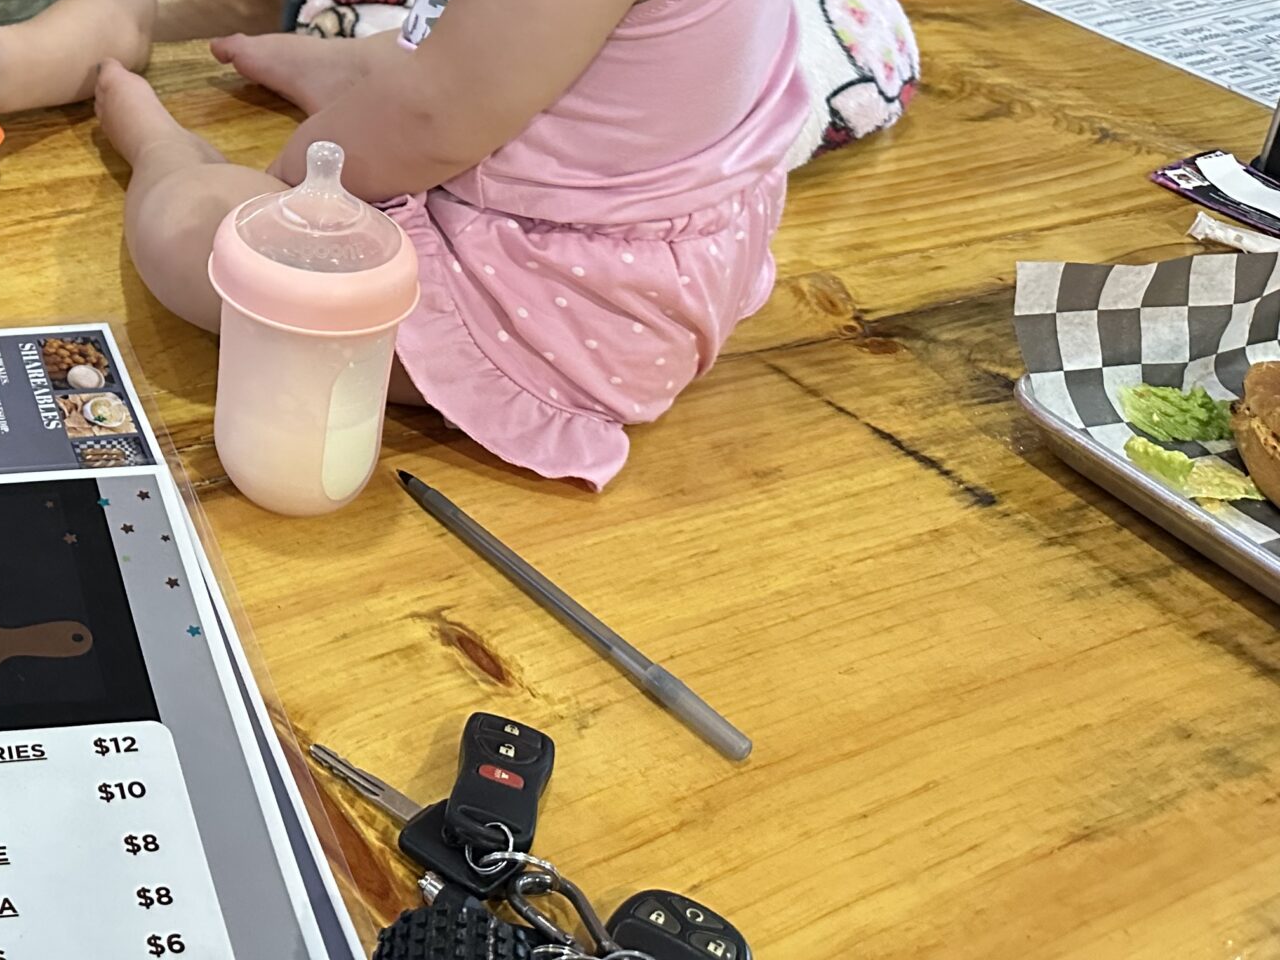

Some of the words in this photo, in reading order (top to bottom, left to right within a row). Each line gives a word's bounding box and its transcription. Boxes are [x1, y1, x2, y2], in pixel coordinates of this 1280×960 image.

[19, 342, 61, 430] SHAREABLES
[92, 735, 139, 757] $12
[97, 780, 147, 803] $10
[123, 833, 160, 856] $8
[136, 886, 174, 909] $8
[146, 933, 186, 958] $6
